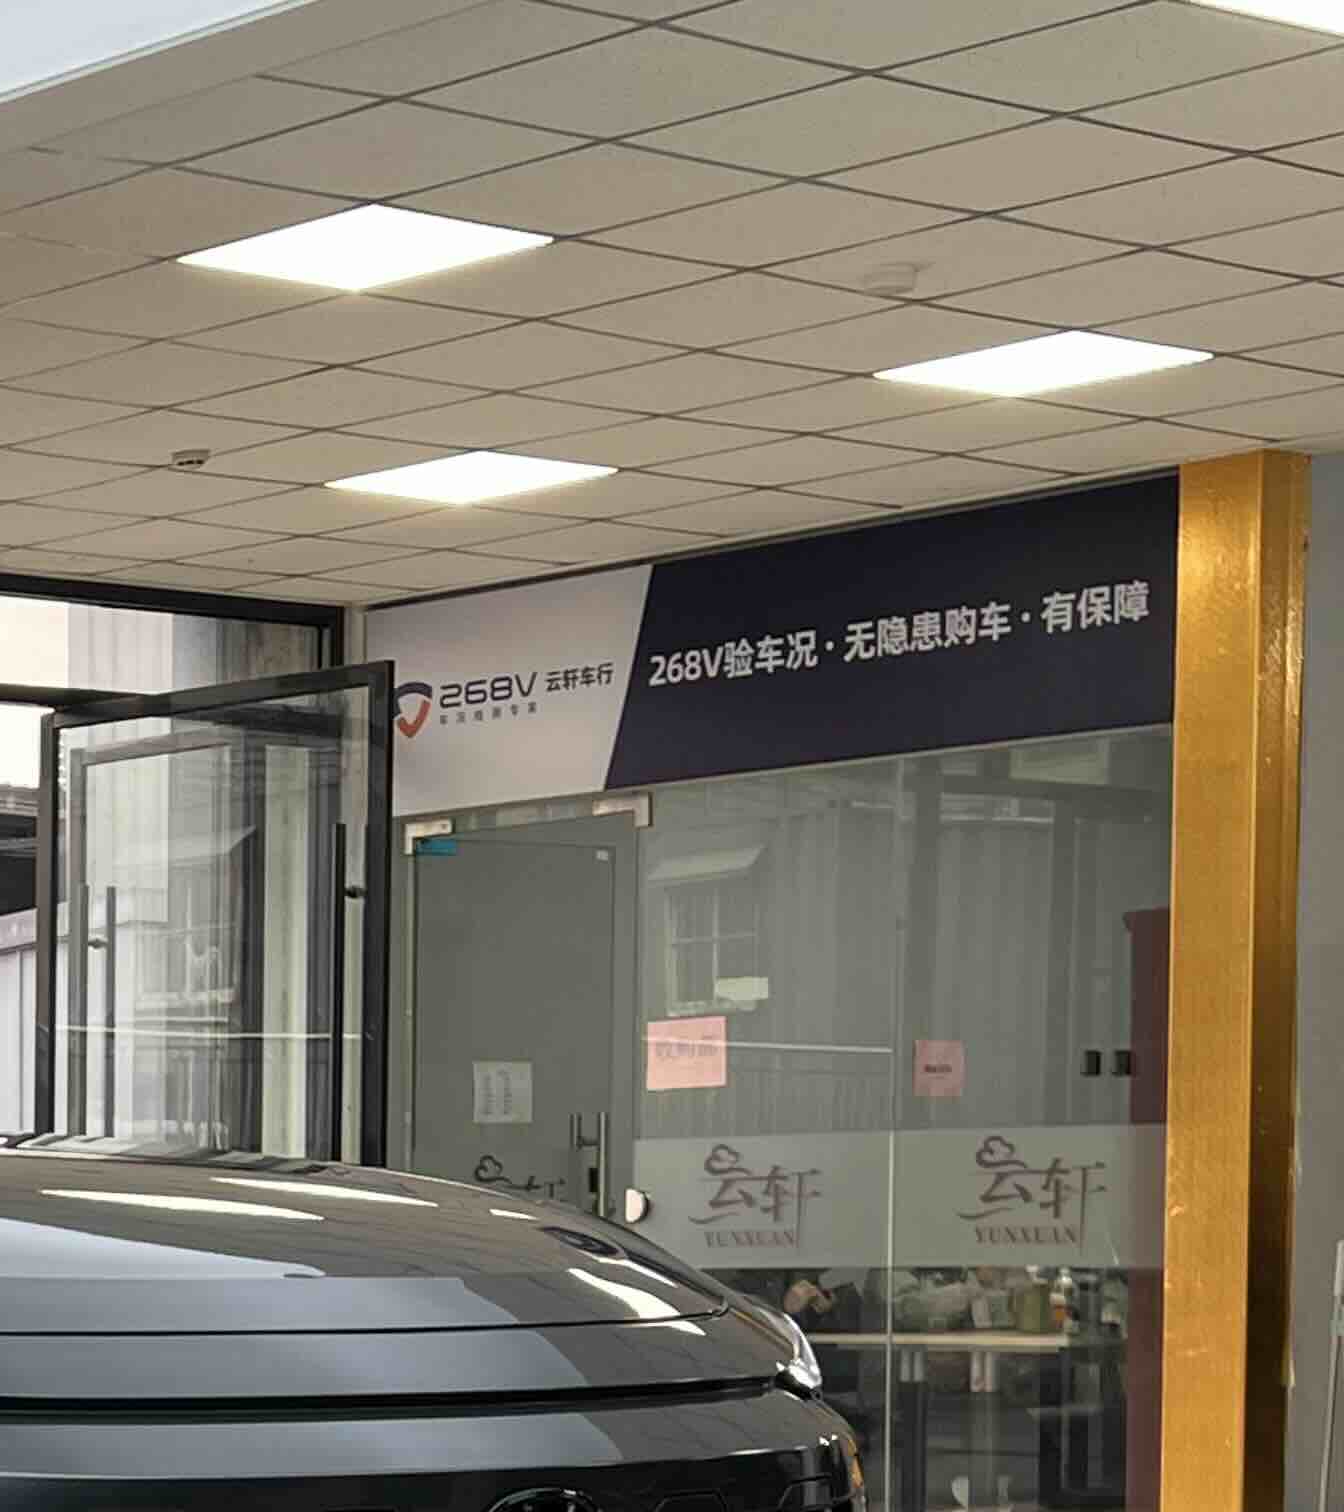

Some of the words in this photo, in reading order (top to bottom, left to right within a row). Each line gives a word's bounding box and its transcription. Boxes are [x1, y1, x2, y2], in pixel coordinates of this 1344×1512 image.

[440, 671, 538, 709] 268V
[544, 662, 614, 693] 云轩车行
[974, 1225, 1080, 1245] YUNXUAN
